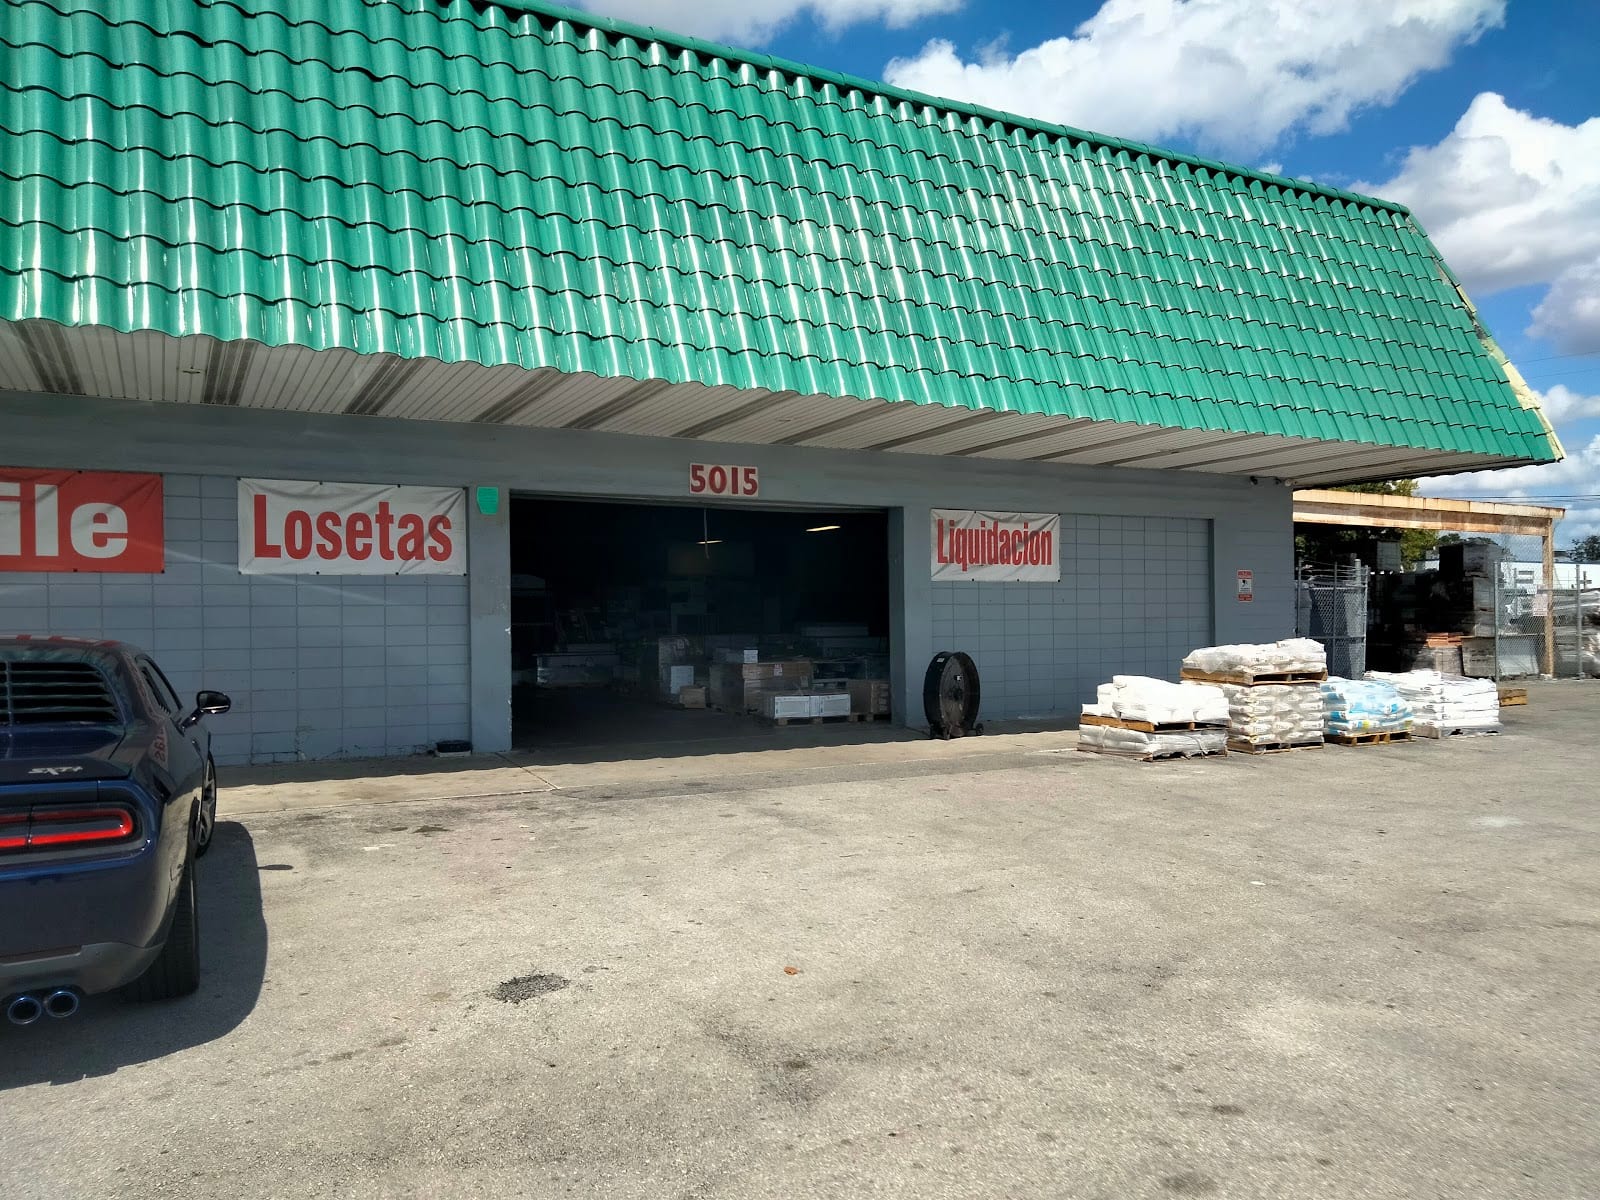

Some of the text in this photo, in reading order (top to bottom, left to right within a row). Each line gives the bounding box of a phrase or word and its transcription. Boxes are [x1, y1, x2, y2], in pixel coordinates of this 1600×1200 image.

[690, 464, 758, 496] 5015
[253, 494, 453, 562] Losetas
[937, 519, 1052, 572] Liquidacion
